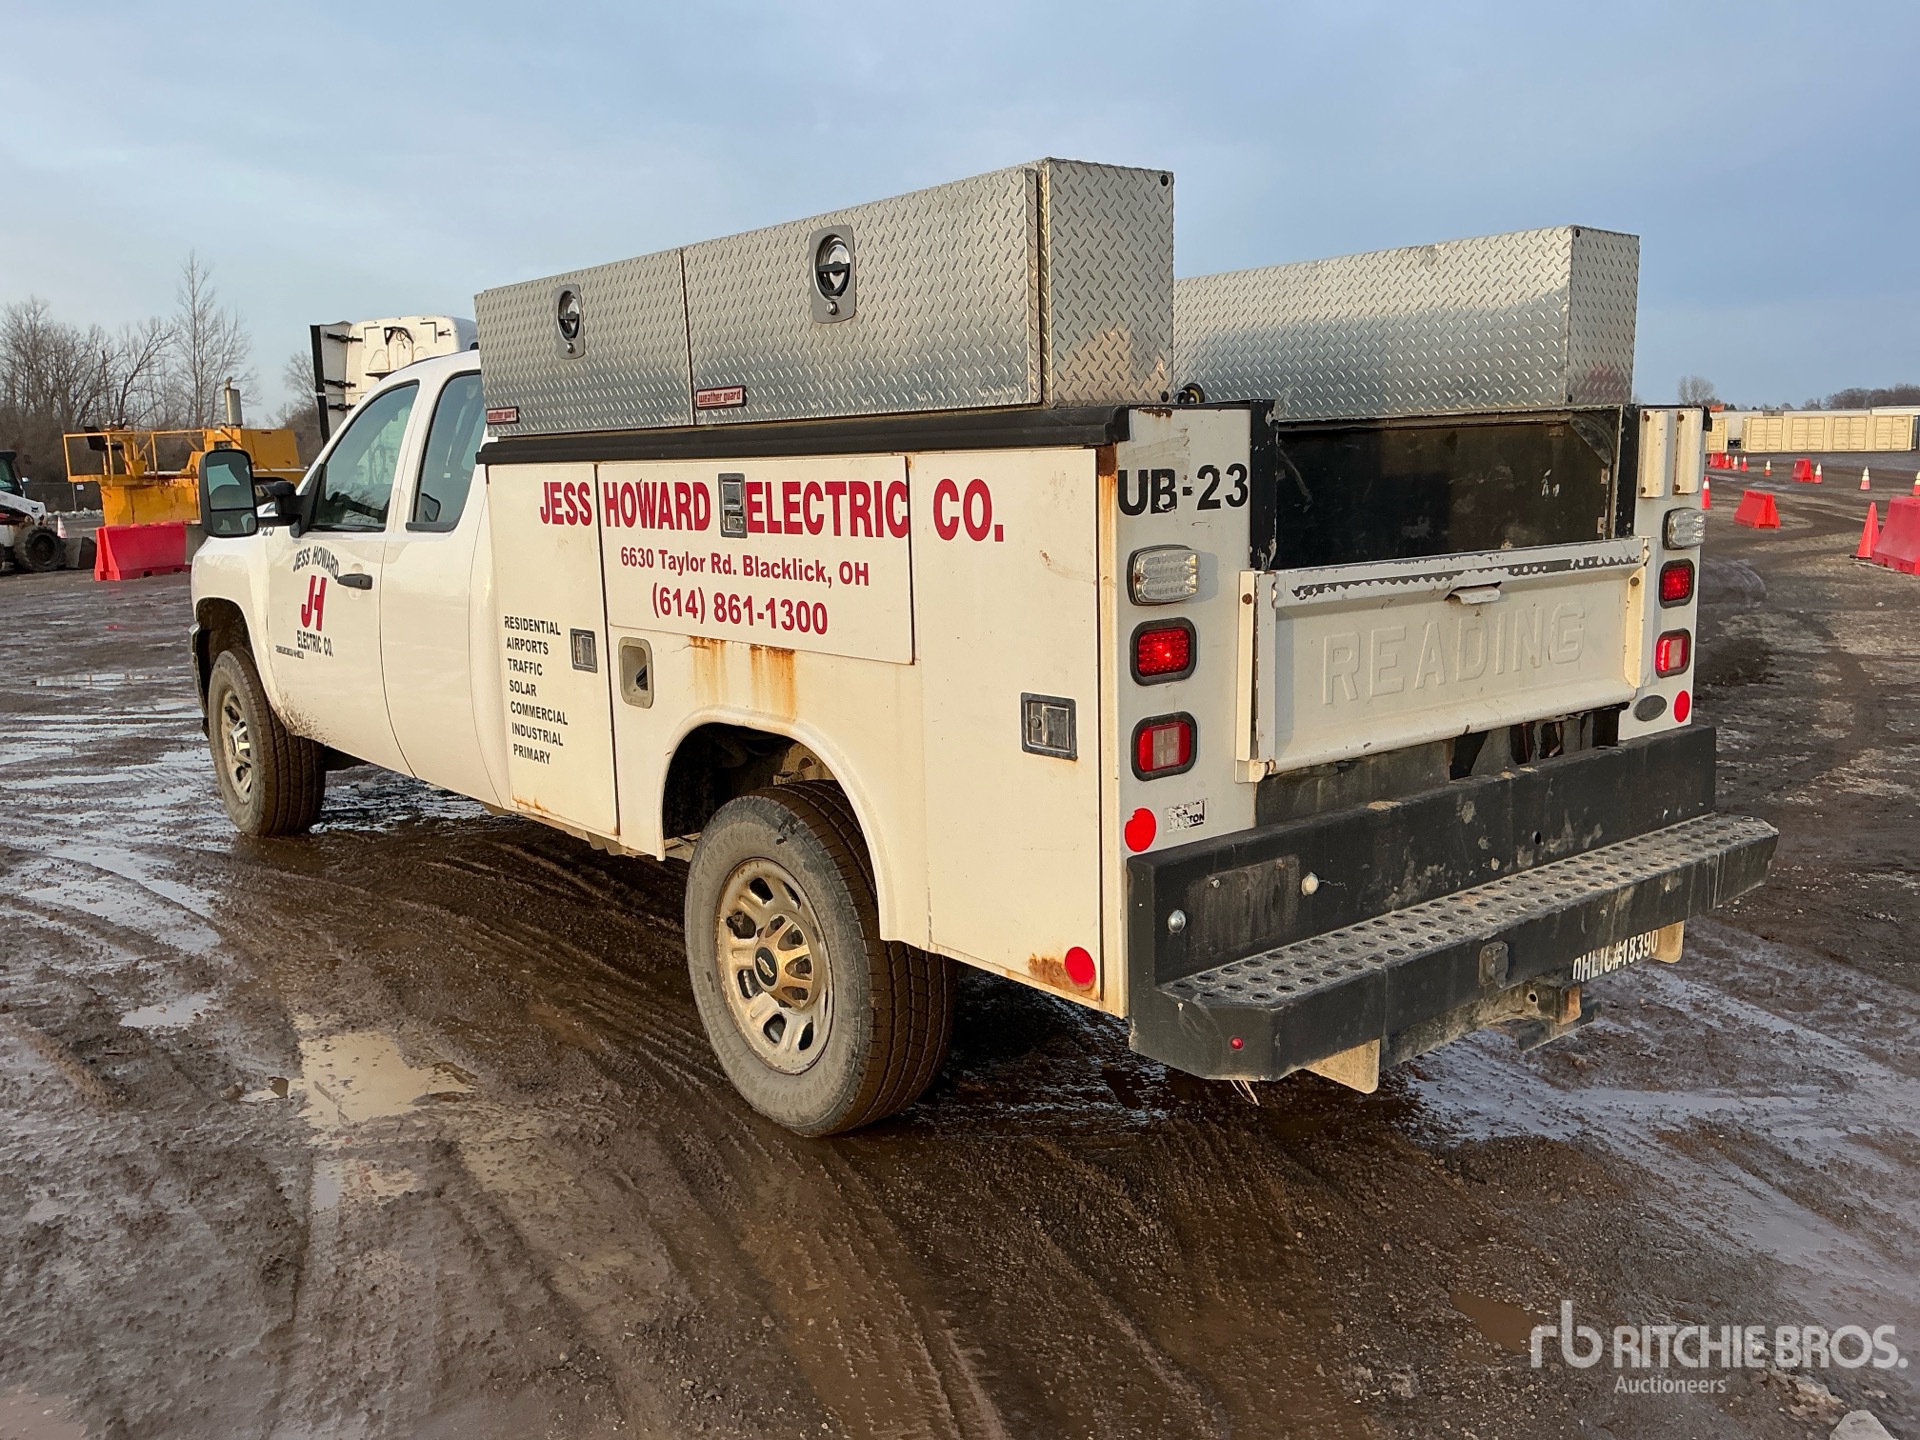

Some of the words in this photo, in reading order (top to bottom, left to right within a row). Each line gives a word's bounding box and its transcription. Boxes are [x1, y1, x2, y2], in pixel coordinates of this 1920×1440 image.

[1117, 463, 1248, 516] UB-23
[540, 481, 592, 526] JESS
[603, 481, 711, 531] HOWARD
[745, 480, 909, 539] ELECTRIC
[933, 478, 1004, 543] CO.
[292, 547, 311, 572] JESS
[312, 545, 340, 580] HOWARD
[620, 547, 654, 569] 6630
[658, 550, 706, 577] Taylor
[711, 552, 737, 576] Rd.
[742, 554, 833, 588] Blacklick,
[838, 560, 870, 587] OH
[652, 582, 706, 625] (614)
[713, 592, 828, 635] 861-1300
[504, 615, 562, 636] RESIDENTIAL
[296, 629, 322, 654] ELECTRIC
[324, 637, 334, 658] CO.
[506, 636, 549, 656] AIRPORTS
[1321, 601, 1587, 706] READING
[507, 657, 543, 676] TRAFFIC
[509, 679, 537, 698] SOLAR
[510, 700, 569, 726] COMMERCIAL
[511, 721, 564, 747] INDUSTRIAL
[513, 743, 551, 765] PRIMARY
